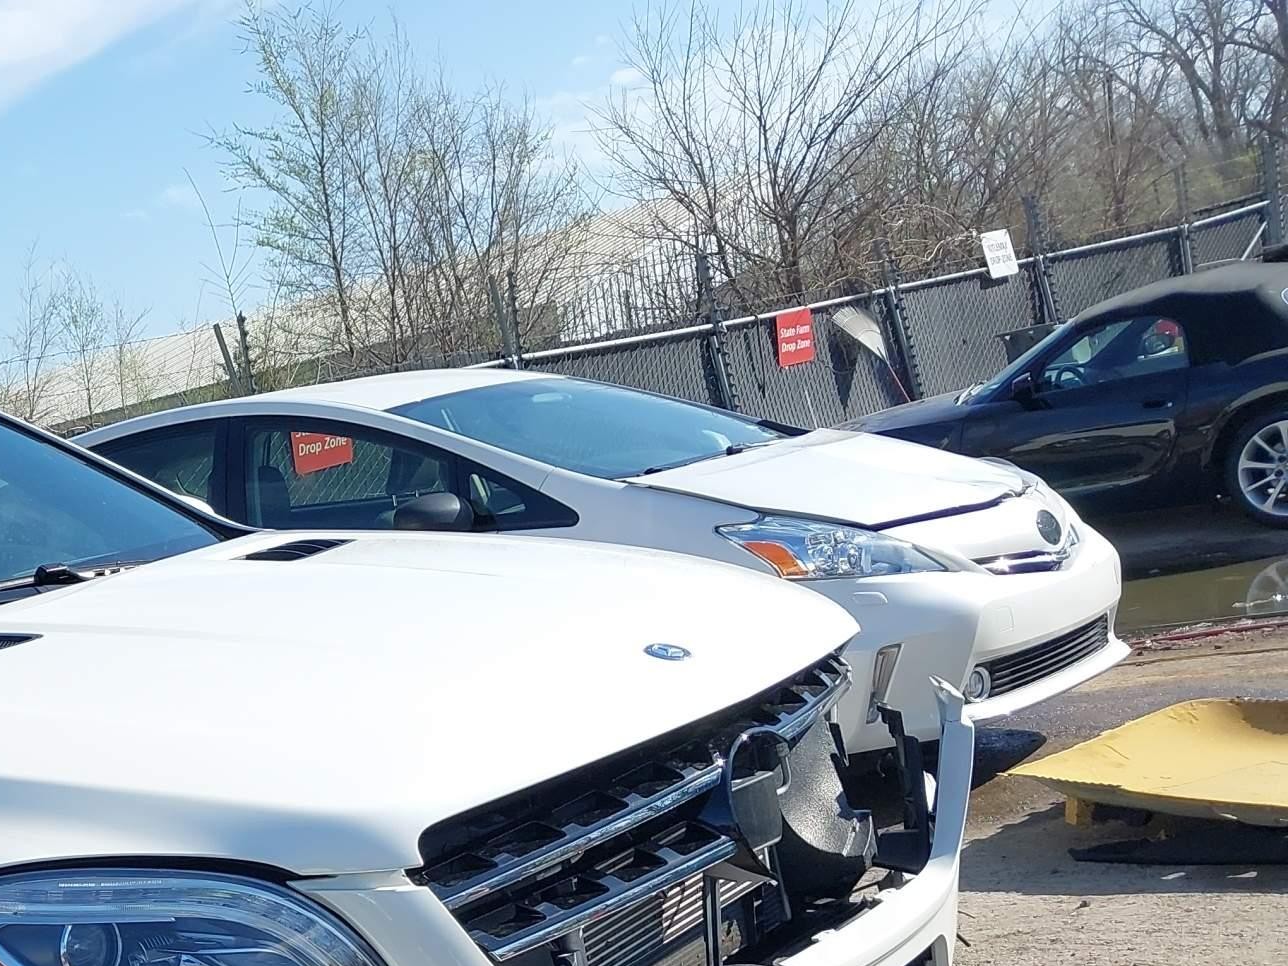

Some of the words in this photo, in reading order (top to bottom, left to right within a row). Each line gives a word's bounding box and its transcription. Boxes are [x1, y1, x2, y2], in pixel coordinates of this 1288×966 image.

[780, 327, 796, 338] State
[796, 324, 810, 335] Farm
[782, 342, 796, 353] Drop
[797, 339, 811, 350] Zone
[298, 442, 323, 457] Drop
[324, 436, 348, 450] Zone
